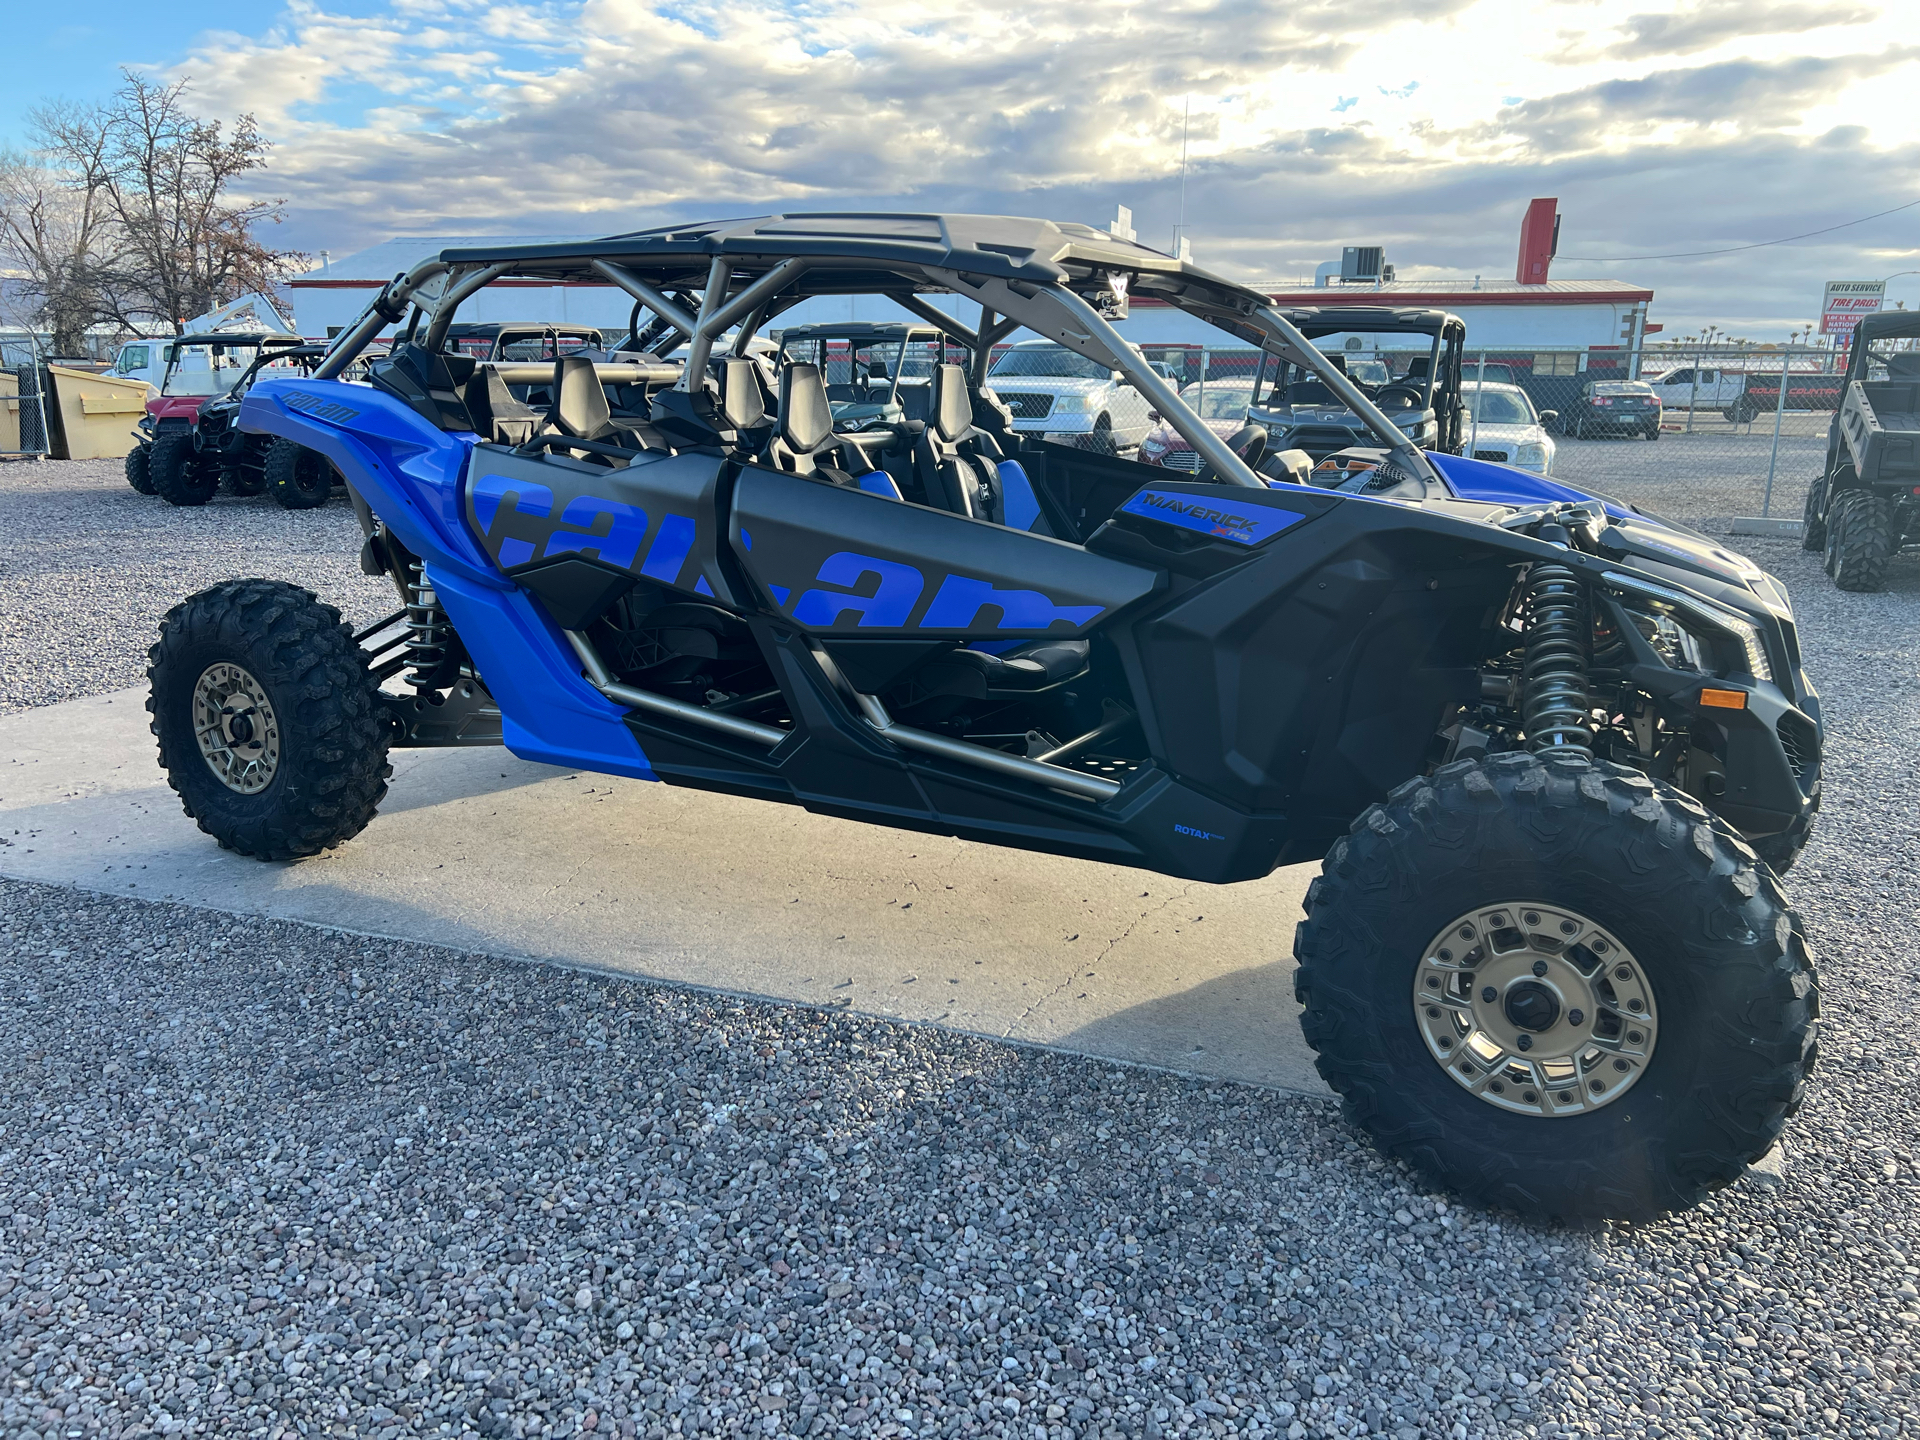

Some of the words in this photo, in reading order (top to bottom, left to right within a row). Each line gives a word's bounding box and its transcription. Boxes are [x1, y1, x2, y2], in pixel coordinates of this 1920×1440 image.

[1830, 284, 1850, 292] AUTO
[1851, 284, 1882, 292] SERVICE
[1828, 298, 1853, 311] TIRE
[1850, 298, 1880, 312] PROS
[1749, 387, 1781, 395] ROUG
[280, 391, 360, 423] can-am
[1142, 493, 1260, 533] MAVERICK
[1174, 823, 1210, 840] ROTAX
